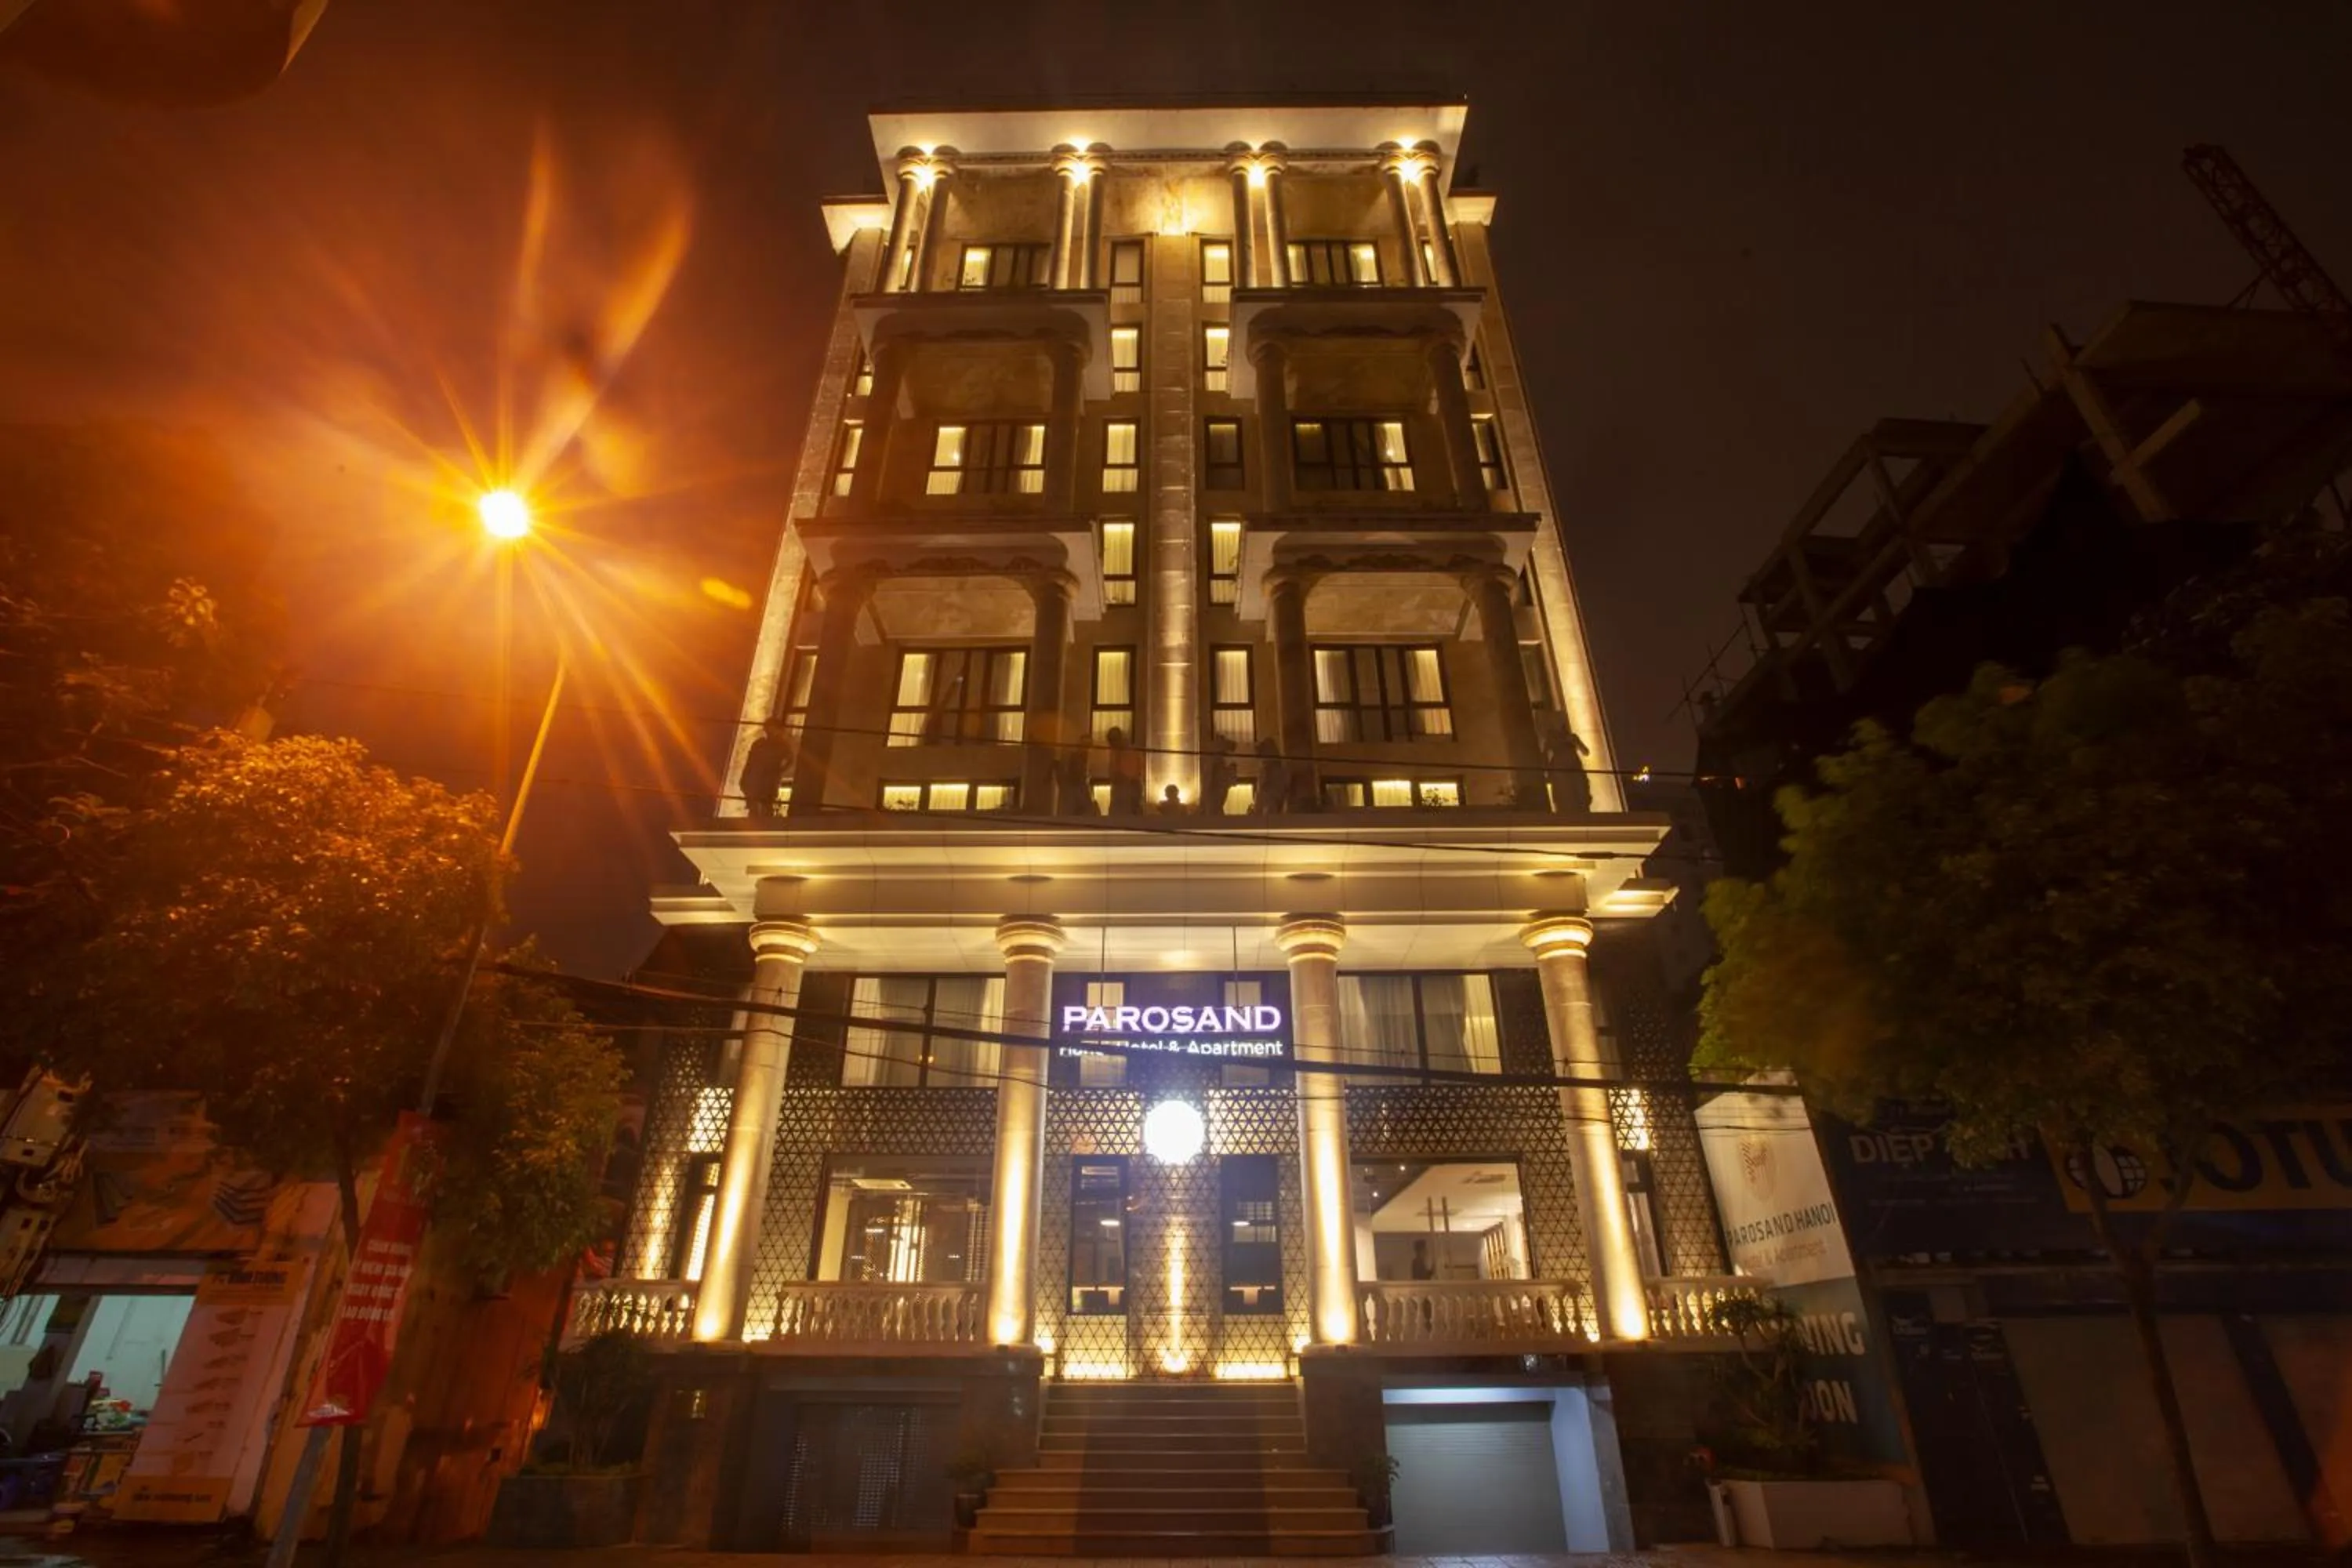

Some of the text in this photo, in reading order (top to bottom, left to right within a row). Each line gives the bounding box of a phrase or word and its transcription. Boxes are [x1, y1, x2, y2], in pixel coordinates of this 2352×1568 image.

[1062, 1005, 1282, 1033] PAROSAND
[1186, 1040, 1284, 1056] Apartment
[1725, 1201, 1837, 1247] PAROSAND HANOI
